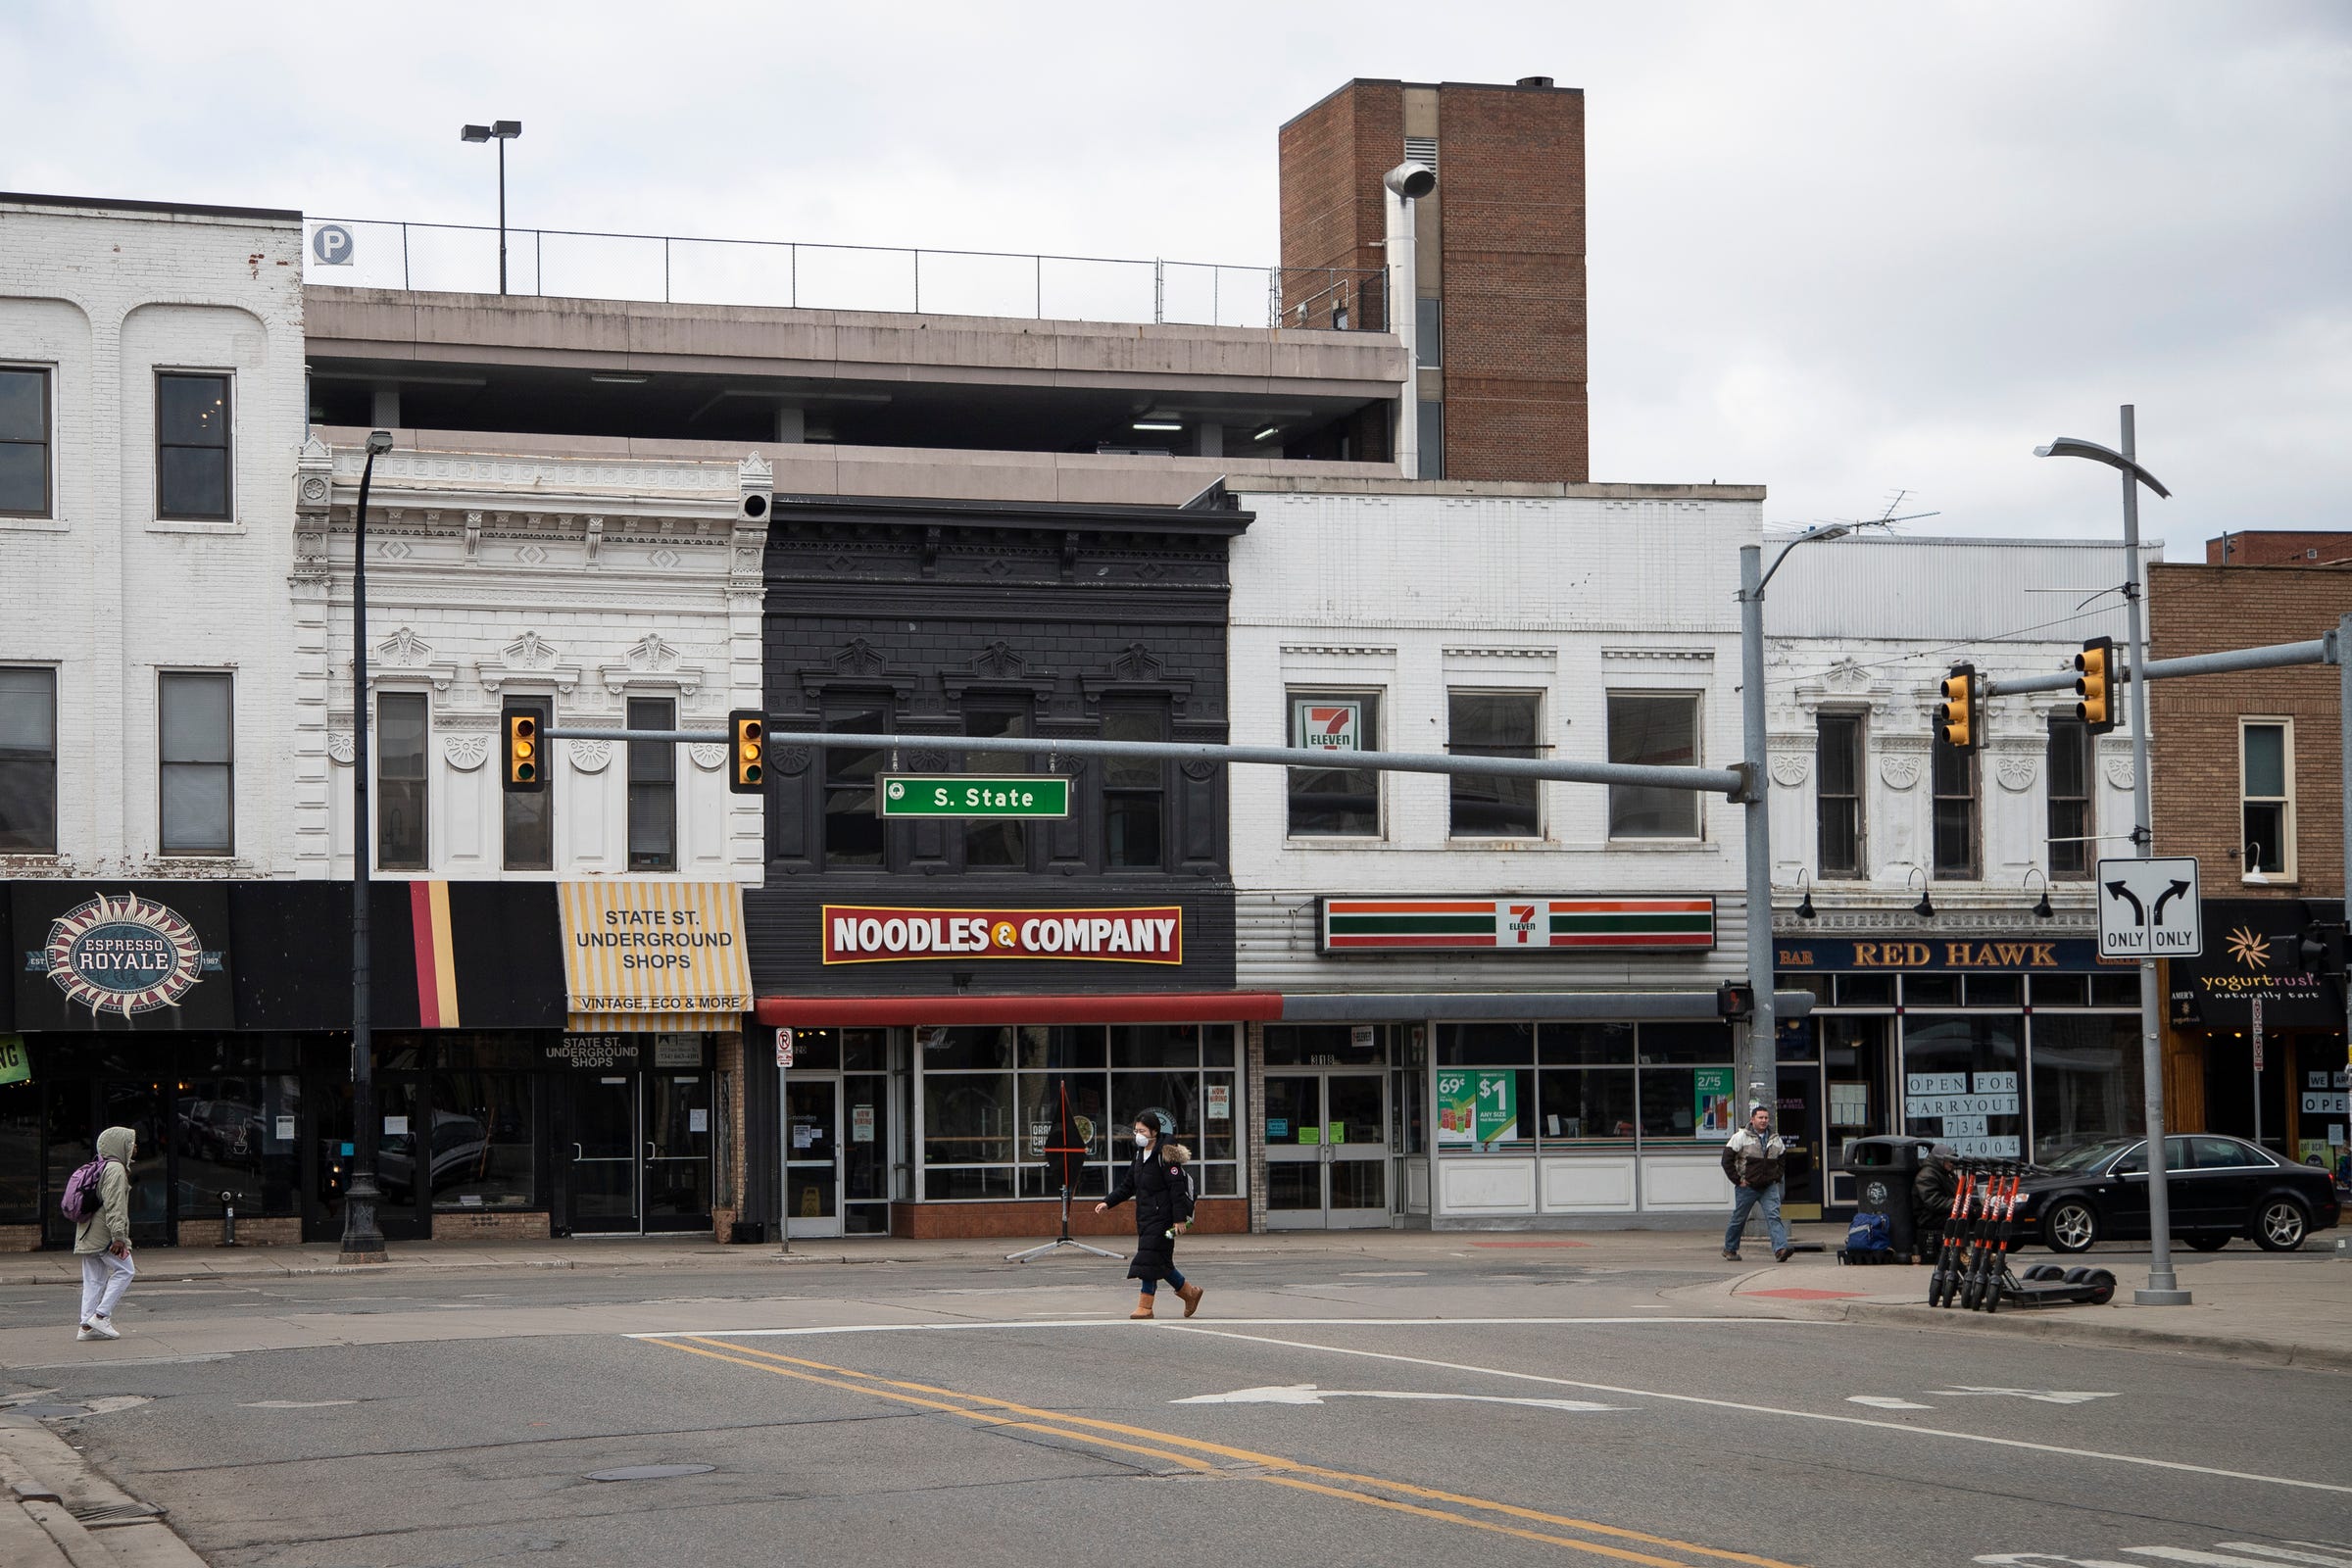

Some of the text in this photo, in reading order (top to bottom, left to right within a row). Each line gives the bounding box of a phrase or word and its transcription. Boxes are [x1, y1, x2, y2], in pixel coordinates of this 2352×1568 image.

[323, 230, 346, 258] P
[933, 787, 1034, 807] S. State
[606, 910, 700, 925] STATE ST.
[1509, 906, 1536, 943] 7
[576, 932, 732, 948] UNDERGROUND
[833, 917, 1177, 953] NOODLES & COMPANY
[2108, 930, 2192, 948] ONLY ONLY
[85, 939, 164, 952] ESPRESSO
[79, 952, 169, 970] ROYALE
[622, 954, 691, 969] SHOPS
[1779, 950, 1814, 965] BAR
[1852, 942, 1931, 966] RED
[1945, 942, 2058, 966] HAWK
[2171, 990, 2194, 1001] AMER'S
[2214, 991, 2281, 1001] naturally
[581, 997, 740, 1011] VINTAGE, ECO & MORE
[563, 1036, 621, 1049] STATE ST.
[545, 1046, 639, 1058] UNDERGROUND
[1310, 1054, 1335, 1065] 318
[571, 1056, 613, 1068] SHOPS
[1439, 1078, 1465, 1094] 69¢
[1910, 1076, 2015, 1091] OPEN FOR
[2311, 1076, 2326, 1085] WE
[1479, 1078, 1506, 1110] $1
[1905, 1098, 2016, 1114] CARRYOUT
[2305, 1099, 2343, 1111] OPE
[1947, 1121, 1984, 1134] 734
[1033, 1136, 1048, 1146] CHI
[1922, 1141, 2016, 1154] 944004
